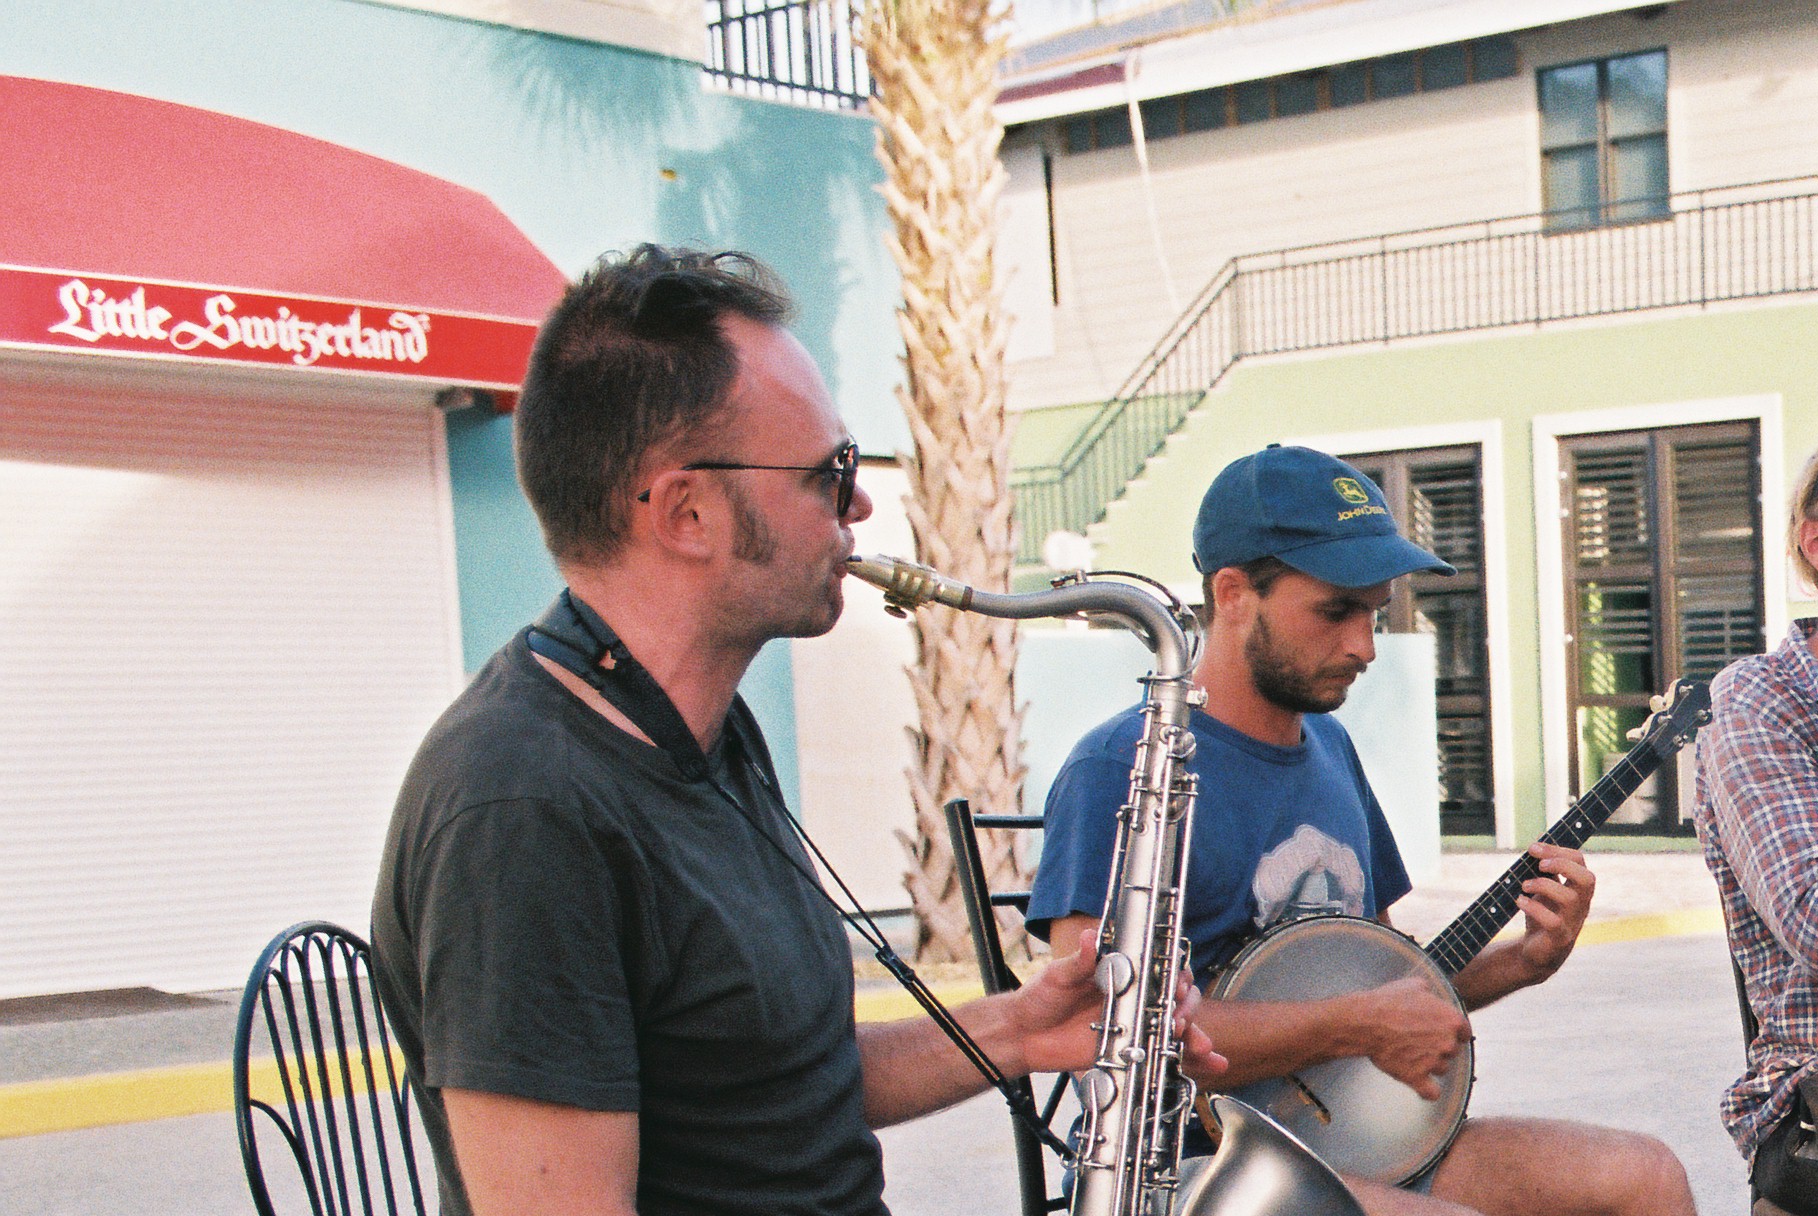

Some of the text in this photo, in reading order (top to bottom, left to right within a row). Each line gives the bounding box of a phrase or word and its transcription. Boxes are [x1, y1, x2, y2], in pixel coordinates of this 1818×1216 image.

[48, 278, 429, 365] Little Switzerland
[1337, 507, 1363, 521] JOHN
